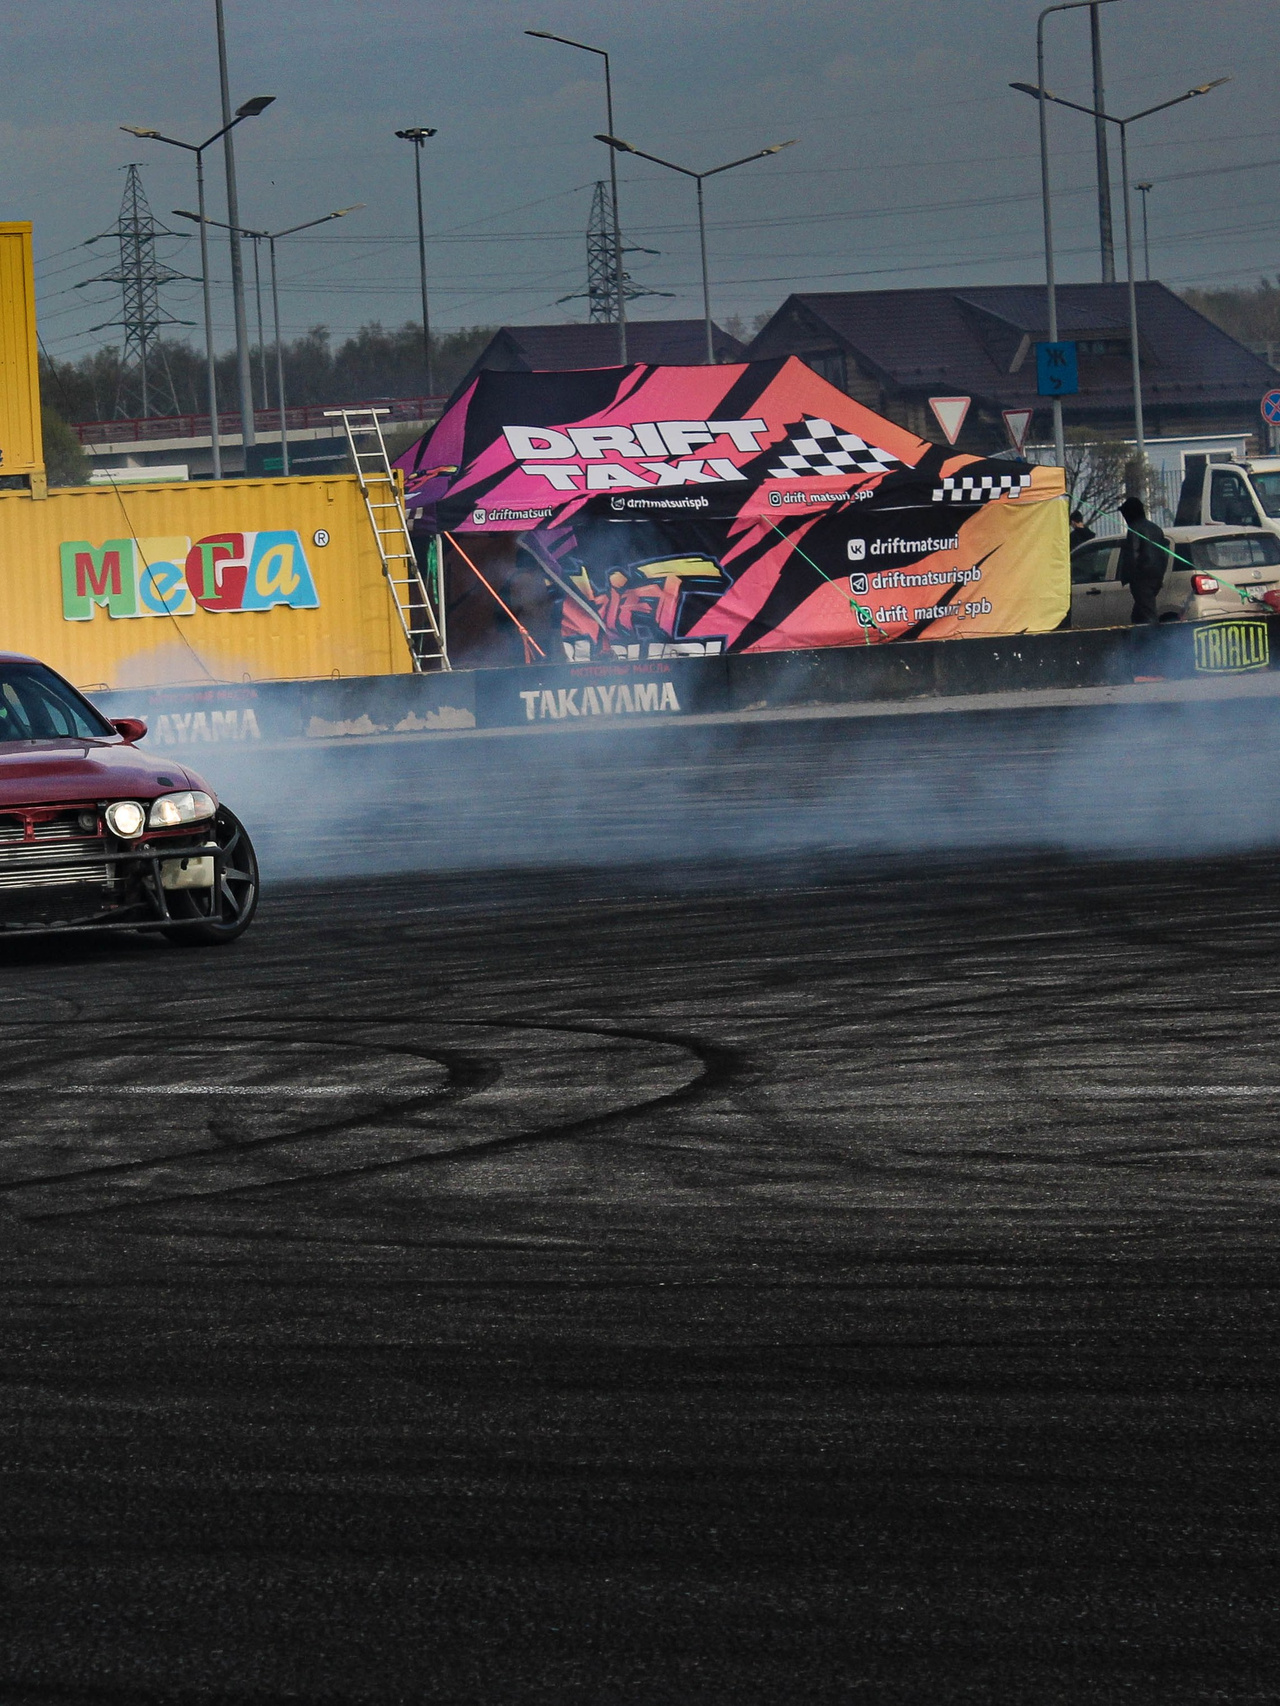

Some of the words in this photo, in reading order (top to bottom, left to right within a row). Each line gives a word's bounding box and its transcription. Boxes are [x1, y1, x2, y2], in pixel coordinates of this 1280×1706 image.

[502, 418, 769, 459] DRIFT
[520, 458, 749, 491] TAXI
[870, 534, 959, 555] driftmatsuri
[872, 566, 982, 589] driftmatsurispb
[1197, 625, 1266, 669] TRIALLI
[520, 682, 681, 720] TAKAYAMA
